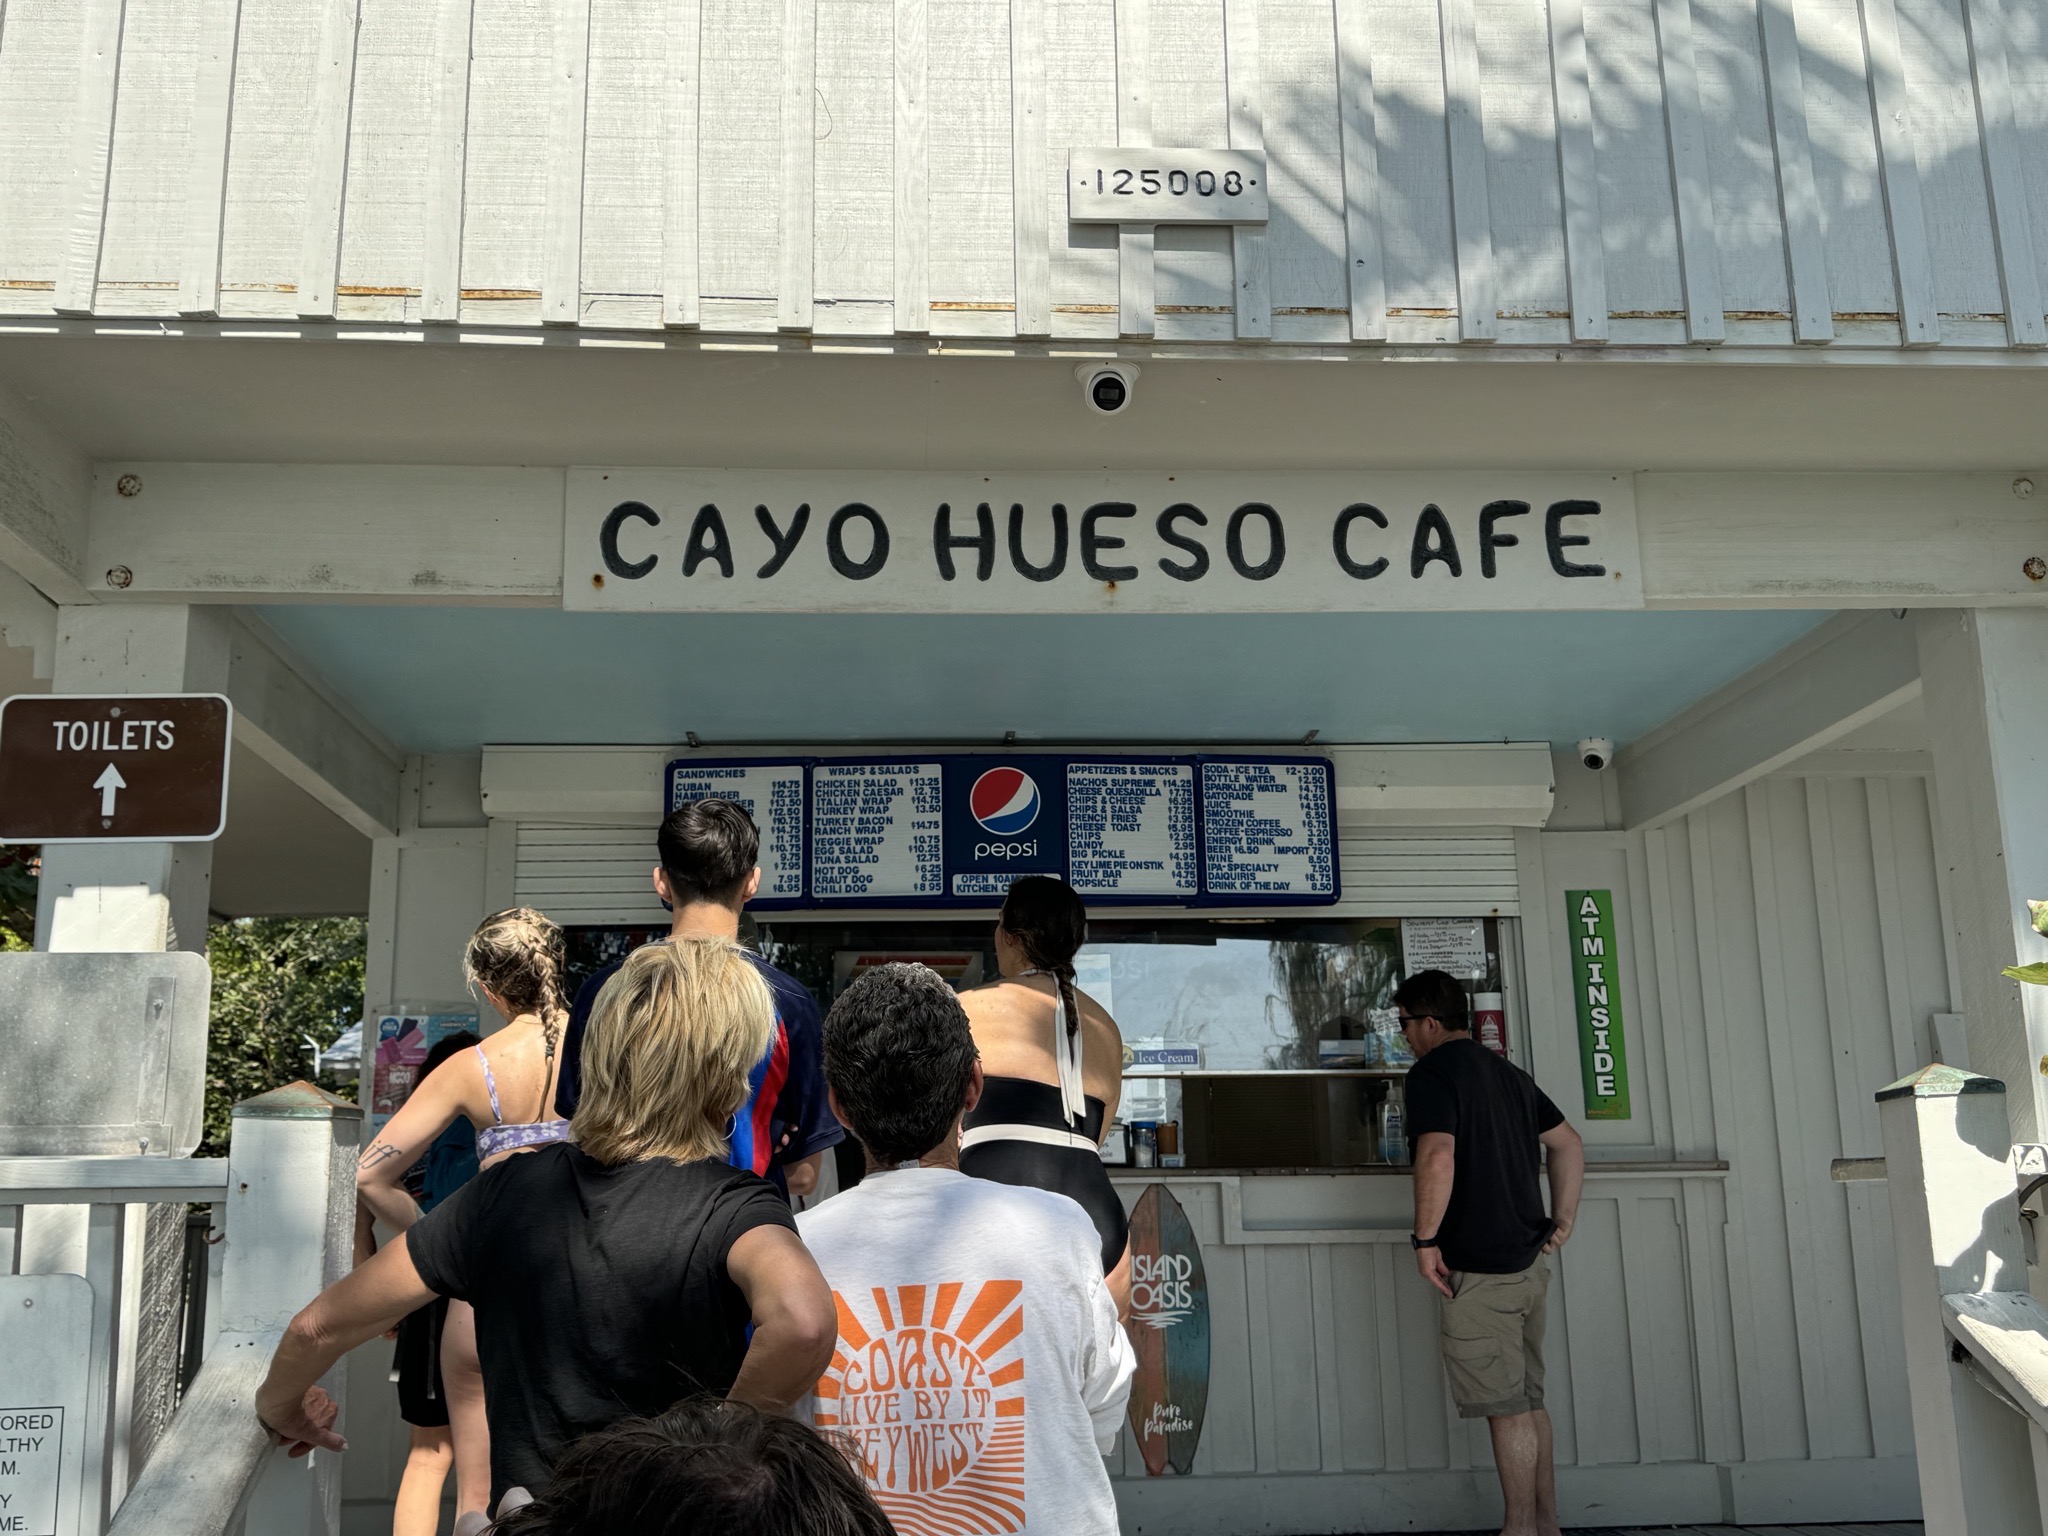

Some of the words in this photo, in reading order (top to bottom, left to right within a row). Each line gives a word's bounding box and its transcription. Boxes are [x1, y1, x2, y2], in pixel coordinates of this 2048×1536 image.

[1097, 169, 1243, 197] 125008
[600, 500, 889, 580] CAYO
[933, 501, 1286, 580] HUESO
[1332, 499, 1606, 579] CAFE
[53, 720, 175, 751] TOILETS
[678, 770, 746, 779] SANDWICHES
[829, 767, 865, 776] WRAPS
[870, 767, 876, 775] &
[878, 766, 919, 774] SALADS
[1068, 766, 1127, 774] APPETIZERS
[1130, 767, 1136, 775] &
[1139, 767, 1177, 775] SNACKS
[1252, 766, 1270, 774] TEA
[816, 780, 860, 788] CHICKEN
[864, 779, 897, 787] SALAD
[910, 778, 939, 786] $13.25
[1069, 778, 1107, 786] NACHOS
[1163, 780, 1191, 788] $14.25
[1245, 775, 1275, 783] WATER
[1298, 776, 1324, 784] $2.50
[676, 783, 711, 791] CUBAN
[772, 781, 800, 789] $14.75
[1205, 784, 1254, 792] SPARKLING
[1299, 785, 1324, 793] $4.75
[676, 791, 739, 800] HAMBURGER
[815, 788, 860, 797] CHICKEN
[863, 788, 904, 796] CAESAR
[1069, 787, 1102, 795] CHEESE
[1106, 788, 1161, 796] QUESADILLA
[1169, 788, 1192, 796] $7.75
[862, 797, 892, 805] WRAP
[912, 796, 940, 804] $14.75
[1069, 796, 1097, 804] CHIPS
[1109, 797, 1145, 805] CHEESE
[1169, 797, 1192, 805] $6.95
[1204, 801, 1231, 809] JUICE
[769, 808, 800, 816] $12.50
[816, 807, 855, 815] TURKEY
[915, 805, 940, 813] 13.50
[1168, 806, 1192, 814] $7.25
[1206, 810, 1254, 818] SMOOTHIE
[815, 818, 855, 826] TURKEY
[858, 816, 893, 825] BACON
[1168, 815, 1192, 823] $3.95
[1206, 819, 1244, 827] FROZEN
[1246, 819, 1280, 827] COFFEE
[1303, 820, 1327, 828] $6.75
[772, 826, 800, 834] $14.75
[814, 827, 850, 836] RANCH
[855, 826, 884, 834] WRAP
[912, 821, 939, 830] $14.75
[1168, 824, 1193, 832] $5.95
[1308, 829, 1328, 837] 3.20
[814, 838, 851, 846] VEGGIE
[854, 837, 884, 845] WRAP
[1070, 841, 1103, 849] CANDY
[1174, 842, 1194, 850] 2.95
[1207, 837, 1242, 845] ENERGY
[1308, 838, 1329, 846] 5.50
[770, 844, 800, 852] $10.75
[909, 845, 940, 853] $10.25
[975, 839, 1036, 860] pepsi
[1235, 846, 1259, 854] $6.50
[815, 856, 841, 864] TUNA
[844, 855, 879, 864] SALAD
[1092, 850, 1125, 858] PICKLE
[1170, 852, 1195, 860] $4.95
[815, 867, 835, 875] HOT
[838, 866, 859, 874] DOG
[1311, 865, 1330, 873] 7.50
[778, 875, 800, 883] 7.95
[962, 875, 988, 883] OPEN
[1103, 870, 1121, 878] BAR
[1172, 871, 1195, 879] $4.75
[1306, 874, 1331, 882] $8.75
[815, 876, 848, 884] KRAUT
[852, 875, 873, 883] DOG
[774, 884, 800, 892] $8.95
[814, 885, 842, 893] CHILI
[845, 884, 867, 892] DOG
[956, 884, 998, 892] KITCHEN
[1209, 881, 1236, 889] DRINK
[1254, 882, 1272, 890] THE
[1273, 882, 1290, 890] DAY
[1311, 883, 1331, 891] 8.50
[1580, 896, 1605, 956] ATM
[1587, 963, 1617, 1096] INSIDE
[1139, 1051, 1154, 1064] Ice
[1158, 1051, 1194, 1064] Cream
[1131, 1254, 1192, 1282] ISLAND
[1131, 1281, 1192, 1310] OASIS
[844, 1328, 986, 1395] COAST
[840, 1393, 901, 1426] LIVE
[913, 1390, 950, 1420] BY
[962, 1388, 991, 1419] IT
